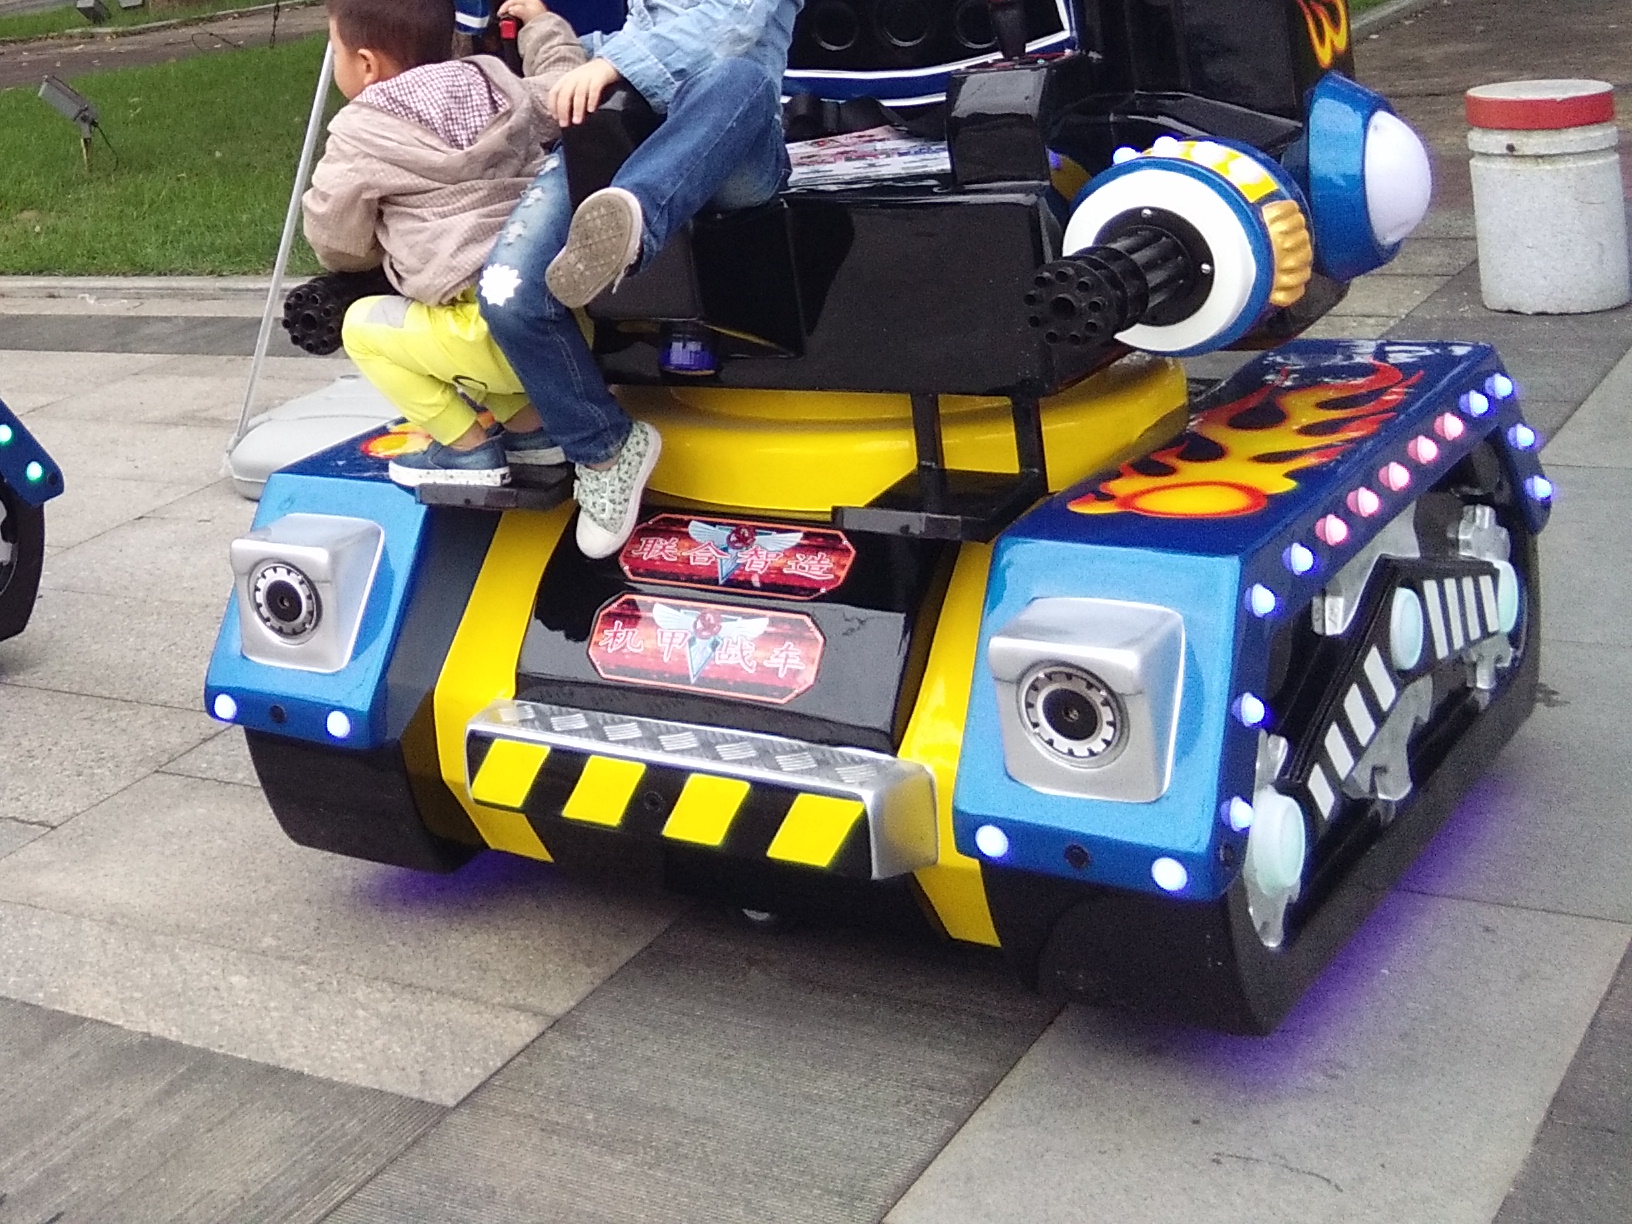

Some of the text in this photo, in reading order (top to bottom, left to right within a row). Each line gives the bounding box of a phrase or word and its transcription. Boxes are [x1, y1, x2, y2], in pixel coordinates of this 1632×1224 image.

[631, 536, 835, 580] 联合智造
[598, 621, 806, 679] 机甲战车
